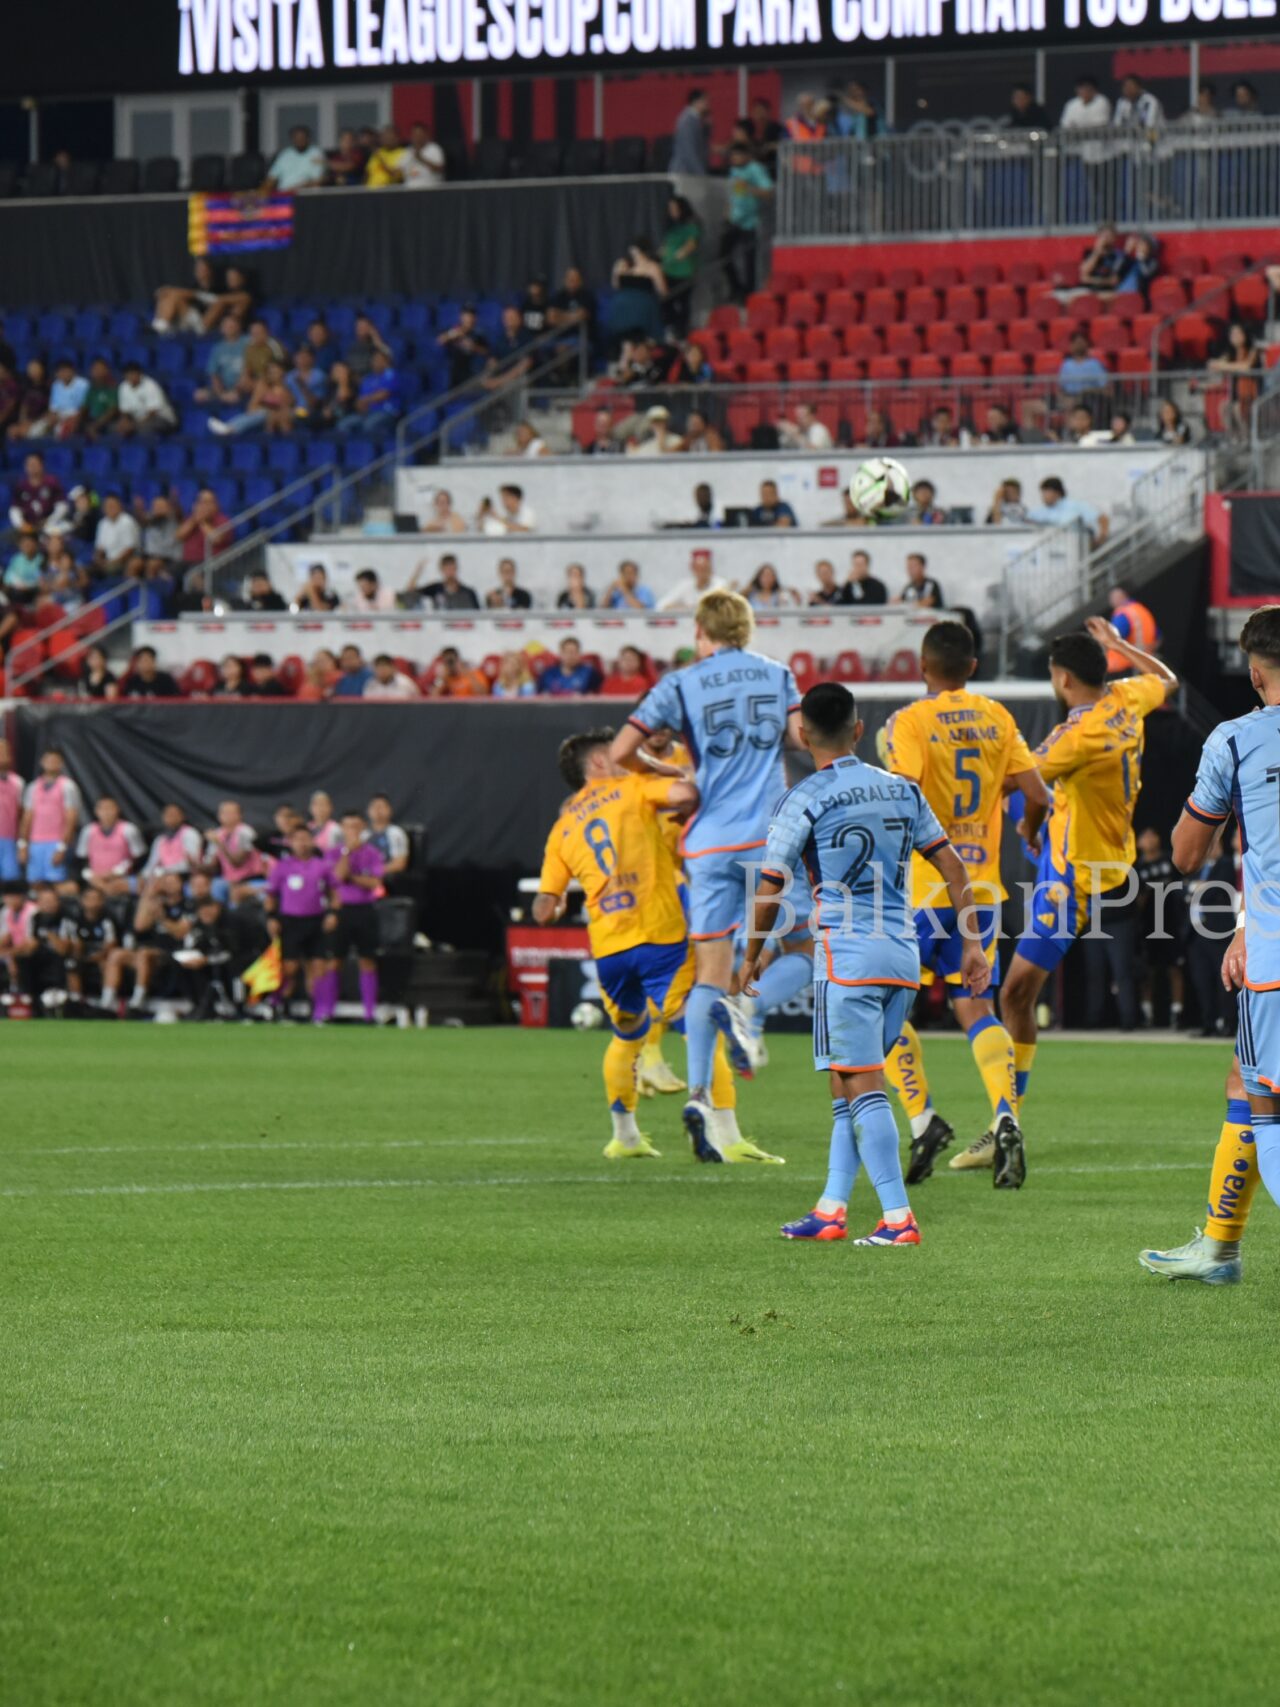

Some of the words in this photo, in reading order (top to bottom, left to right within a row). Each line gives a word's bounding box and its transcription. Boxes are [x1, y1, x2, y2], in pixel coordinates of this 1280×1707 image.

[333, 0, 697, 67] LEAGUESCUP.COM
[700, 668, 769, 690] KEATON
[703, 694, 780, 758] 55
[820, 784, 911, 811] MORALEZ
[953, 748, 981, 817] 5
[584, 818, 617, 877] 8
[831, 817, 915, 896] 27
